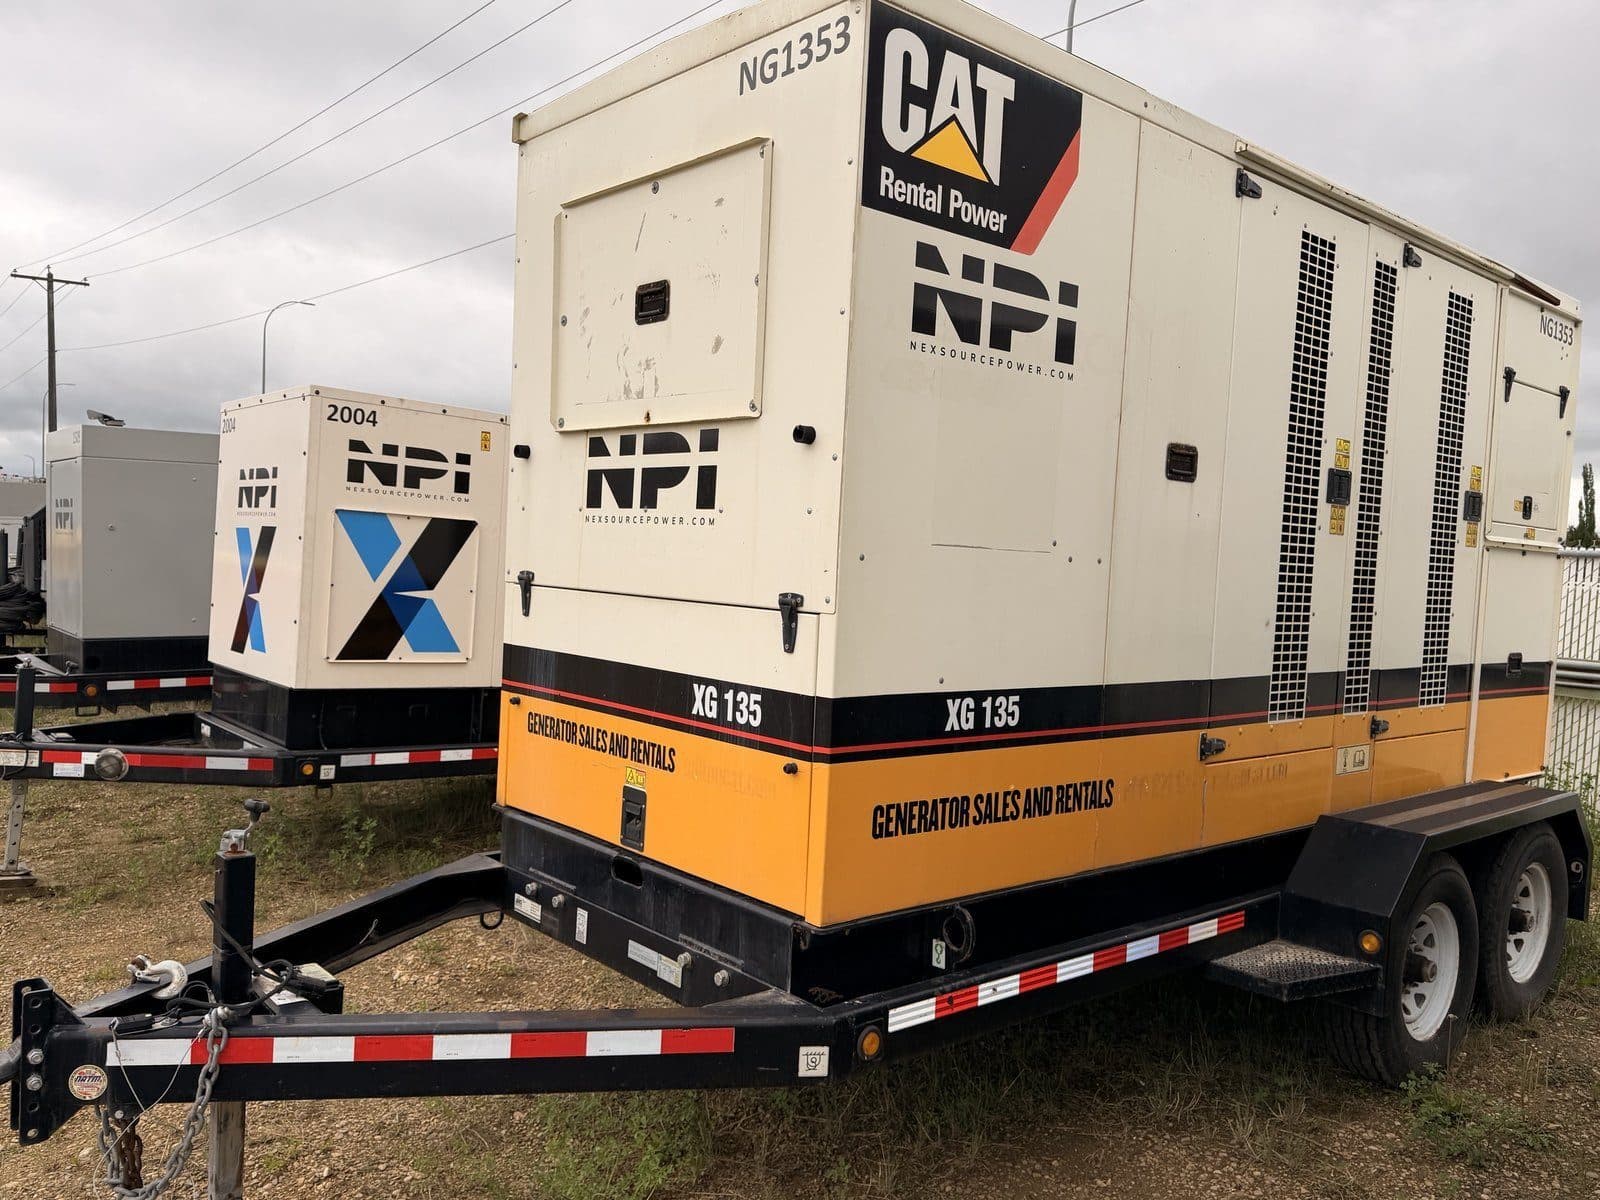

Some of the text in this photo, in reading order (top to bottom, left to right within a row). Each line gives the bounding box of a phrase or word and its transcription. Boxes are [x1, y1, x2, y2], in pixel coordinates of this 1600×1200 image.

[738, 14, 851, 97] NG1353
[881, 27, 1016, 187] CAT
[879, 165, 1008, 234] Rental Power
[1539, 314, 1575, 347] NG1353
[909, 340, 1075, 381] NEXSOURCEPOWER.COM
[326, 403, 379, 428] 2004
[345, 486, 471, 503] NEXSOURCEPOWER.COM
[585, 515, 716, 526] NEXSOURCEPOWER.COM
[691, 683, 762, 728] XG 135
[944, 695, 1020, 732] XG 135
[527, 711, 676, 773] GENERATOR SALES AND RENTALS
[871, 796, 971, 840] GENERATOR
[972, 789, 1021, 826] SALES
[1022, 786, 1054, 820] AND
[1055, 778, 1115, 815] RENTALS
